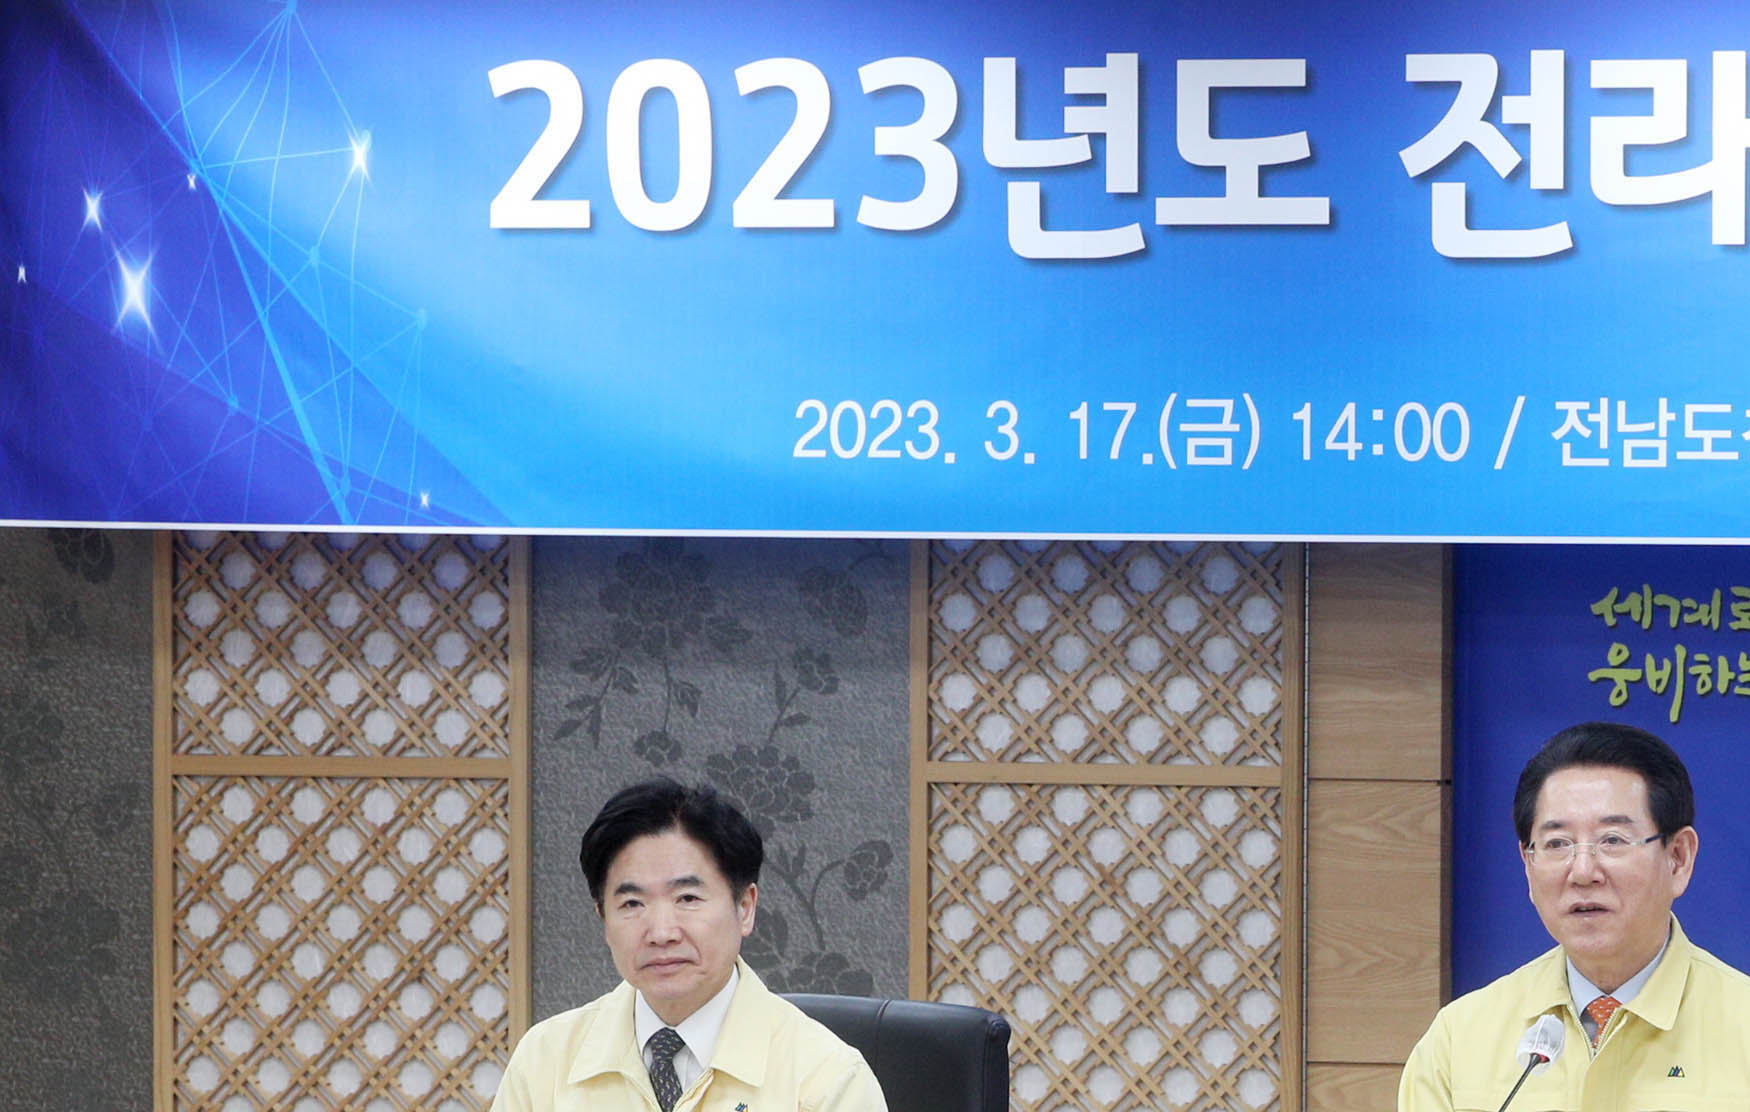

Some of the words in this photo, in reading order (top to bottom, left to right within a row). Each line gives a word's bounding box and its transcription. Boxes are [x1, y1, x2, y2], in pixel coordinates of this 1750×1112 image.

[488, 54, 1329, 258] 2023년도
[794, 400, 956, 463] 2023.
[984, 400, 1035, 463] 3.
[1071, 394, 1260, 468] 17.(금)
[1292, 402, 1470, 461] 14:00
[1495, 397, 1525, 469] /
